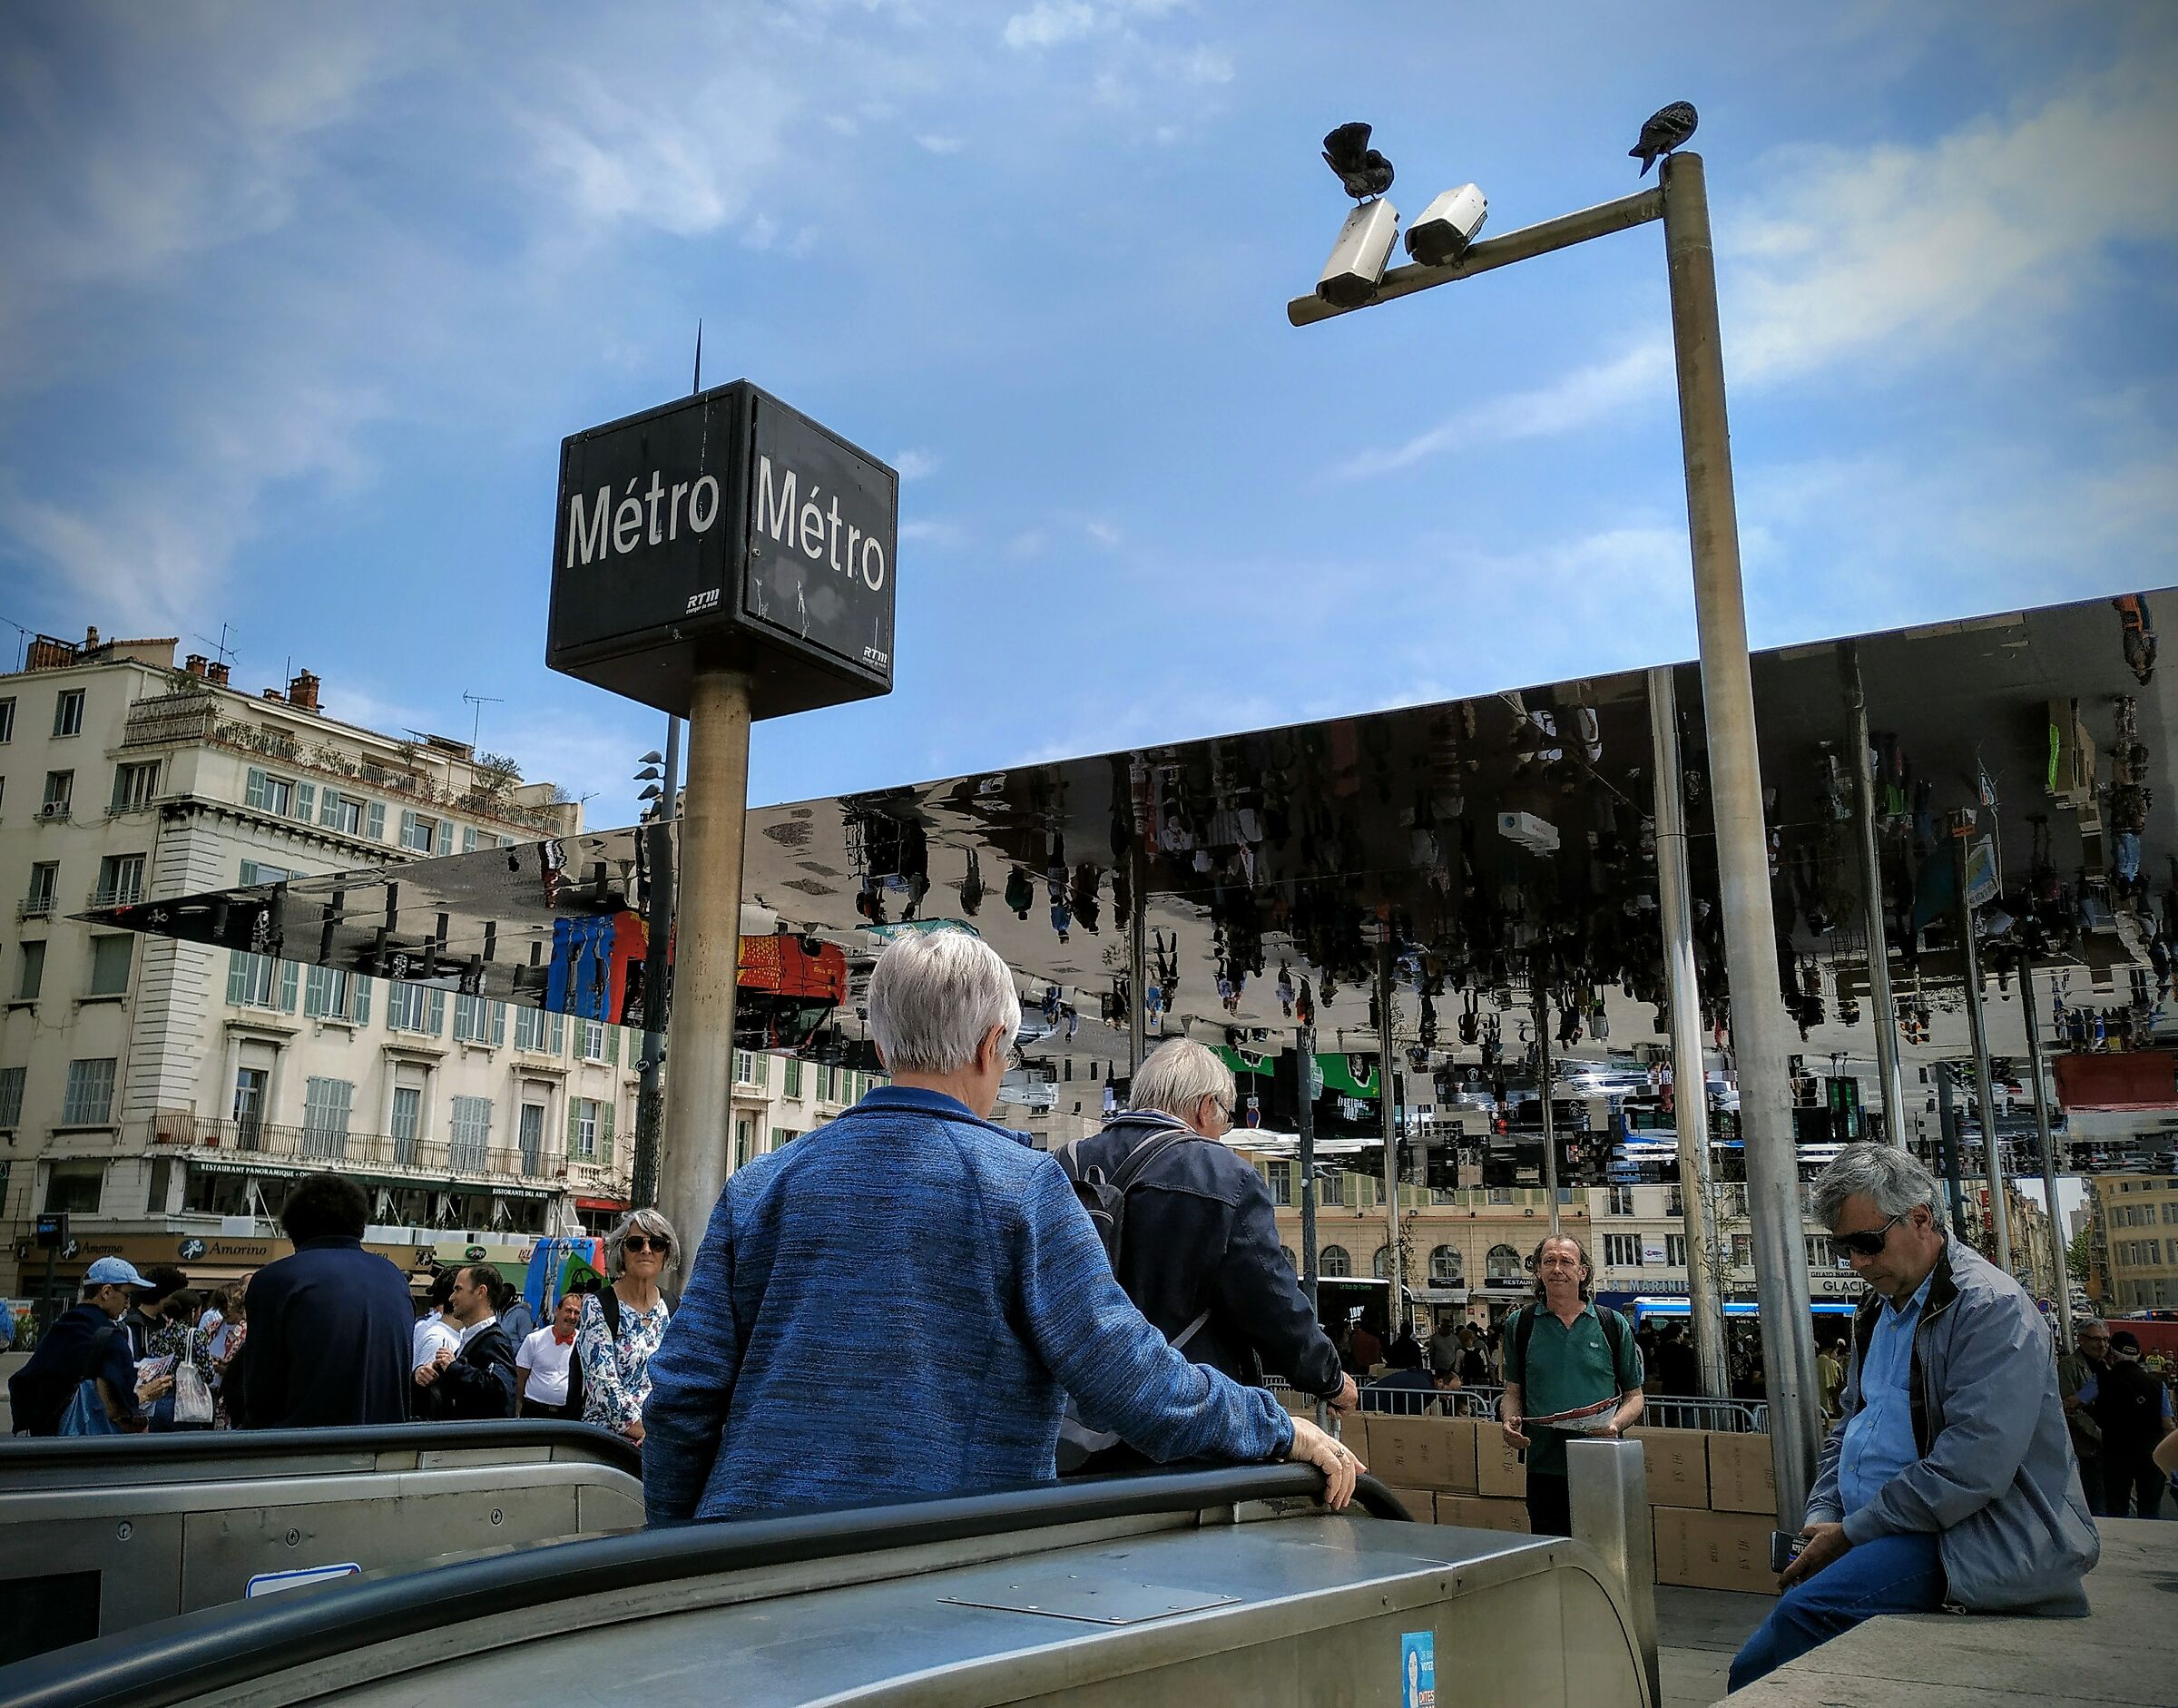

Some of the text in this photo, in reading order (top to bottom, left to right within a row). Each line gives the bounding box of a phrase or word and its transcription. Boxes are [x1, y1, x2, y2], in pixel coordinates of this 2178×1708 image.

[566, 470, 719, 569] Métro
[757, 456, 884, 591] Métro
[687, 588, 720, 608] RTM
[863, 645, 888, 663] RTM
[201, 1163, 245, 1173] RESTAURANT
[246, 1166, 295, 1178] PANORAMIQUE
[492, 1188, 524, 1197] RISTORANTE
[209, 1242, 267, 1255] Amorino
[1418, 1690, 1435, 1703] DITES
